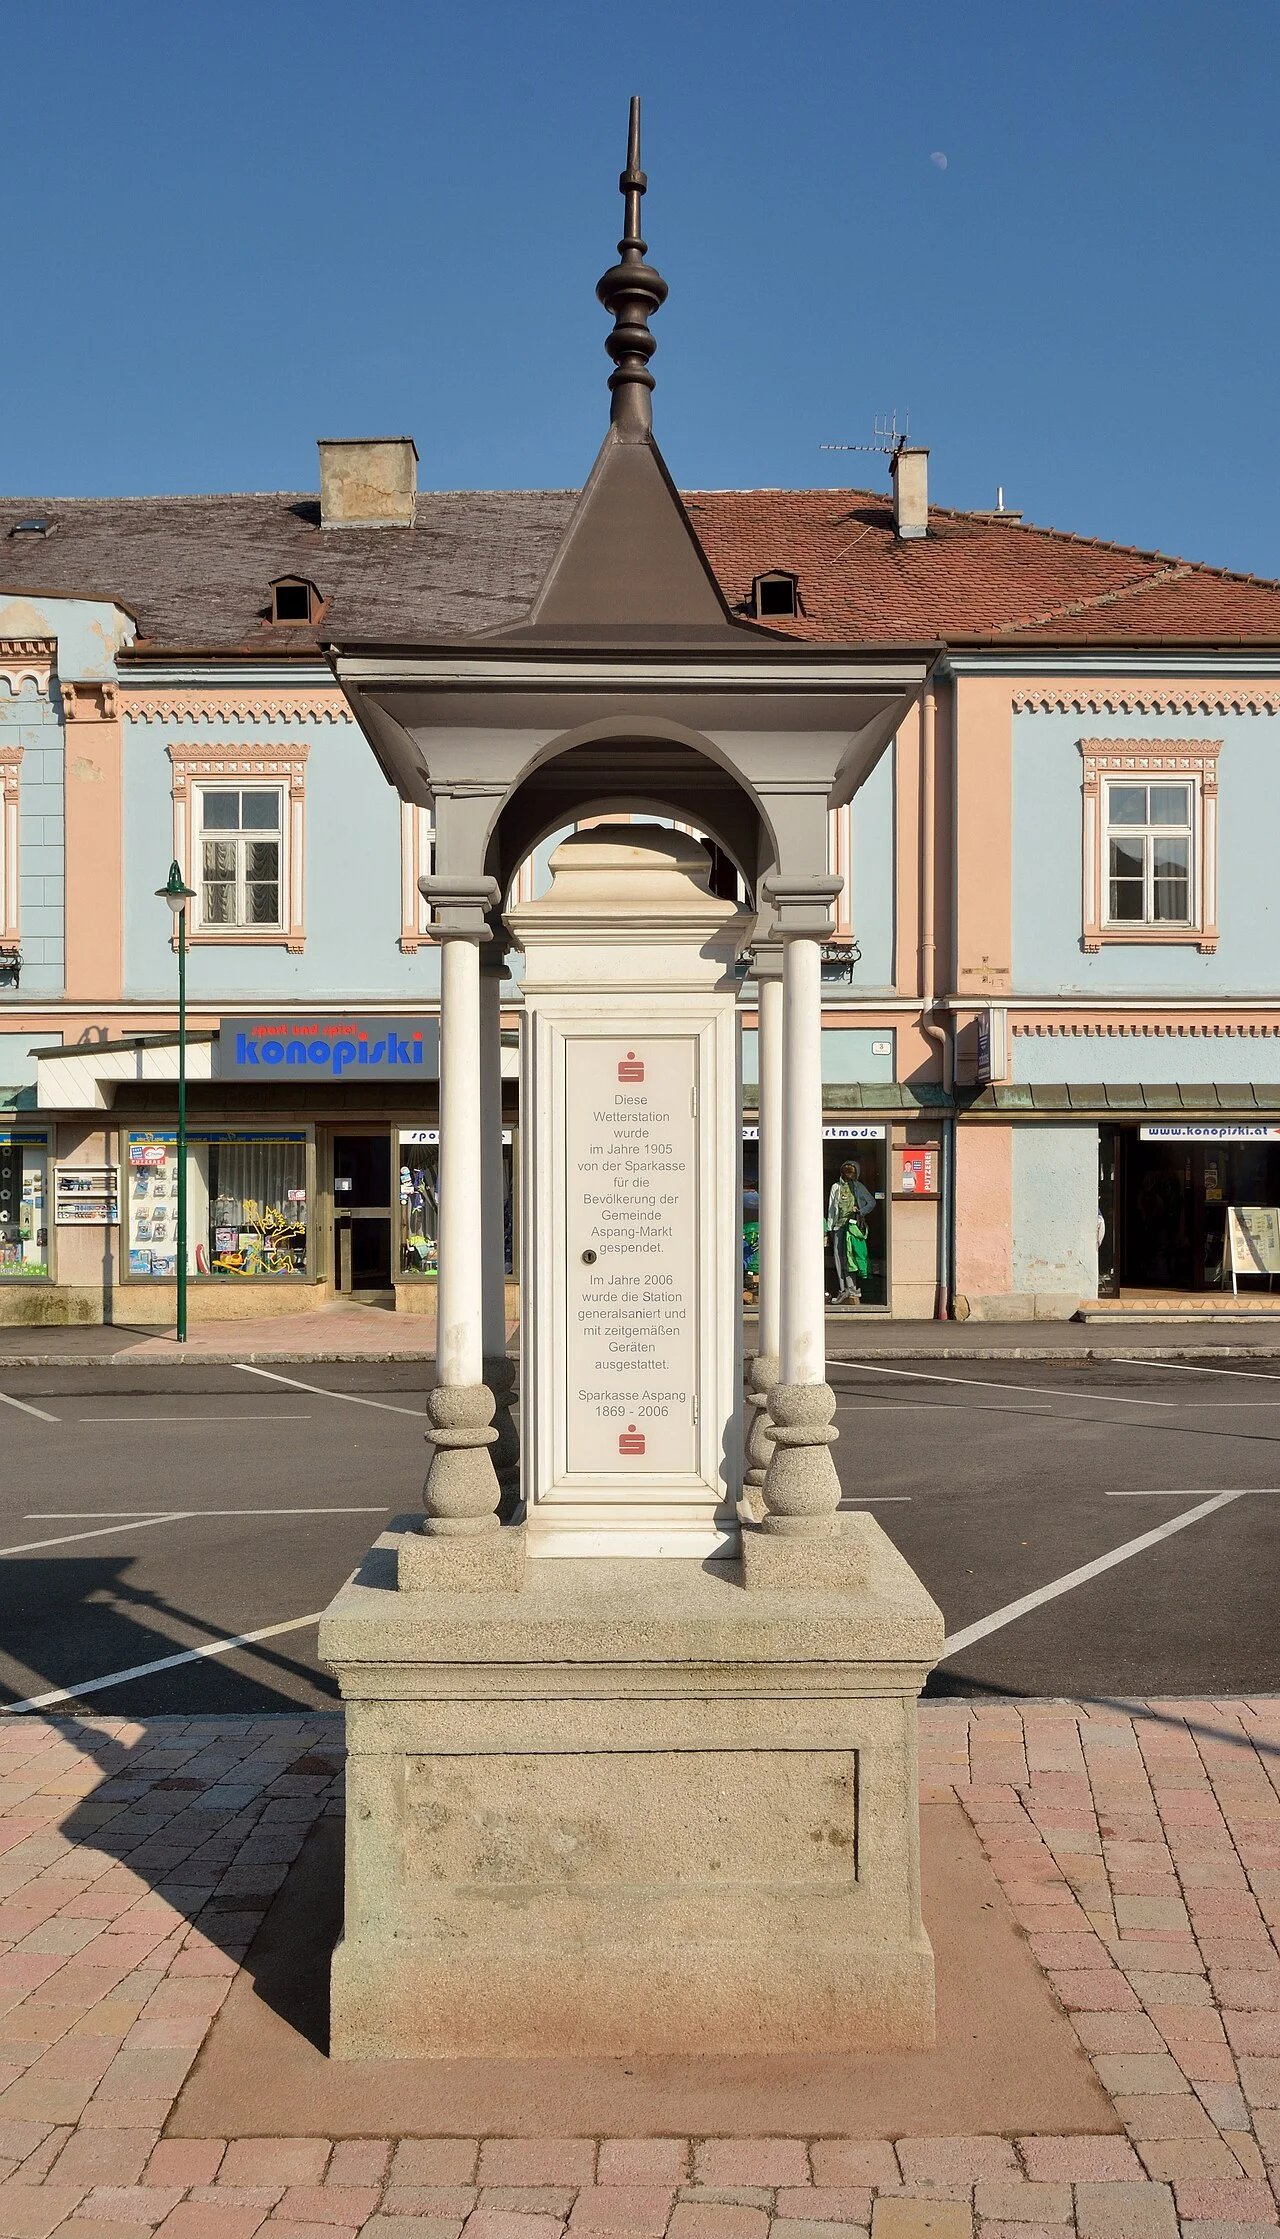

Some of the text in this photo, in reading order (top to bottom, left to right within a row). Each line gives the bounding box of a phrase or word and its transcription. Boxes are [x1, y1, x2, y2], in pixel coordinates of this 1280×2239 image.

[252, 1023, 357, 1037] sport und spiel
[237, 1032, 422, 1074] konopiski
[614, 1094, 648, 1105] Diese
[592, 1111, 670, 1122] Wetterstation
[411, 1132, 439, 1142] spo
[613, 1127, 649, 1138] wurde
[822, 1127, 878, 1137] rtmode
[1149, 1126, 1268, 1137] www.konopiski.at
[589, 1143, 672, 1154] im Jahre 1905
[577, 1160, 686, 1174] von der Sparkasse
[924, 1152, 932, 1191] PUTZEREI
[613, 1176, 650, 1187] für die
[583, 1193, 679, 1207] Bevölkerung der
[601, 1209, 662, 1220] Gemeinde
[590, 1225, 673, 1239] Aspang-Markt
[599, 1242, 664, 1255] gespendet.
[590, 1274, 673, 1285] Im Jahre 2006
[581, 1291, 682, 1302] wurde die Station
[577, 1308, 686, 1322] generalsaniert und
[583, 1324, 680, 1339] mit zeitgemäßen
[608, 1341, 656, 1352] Geräten
[594, 1359, 670, 1373] ausgestattet.
[578, 1389, 686, 1404] Sparkasse Aspang
[595, 1406, 626, 1417] 1869
[637, 1406, 669, 1417] 2006
